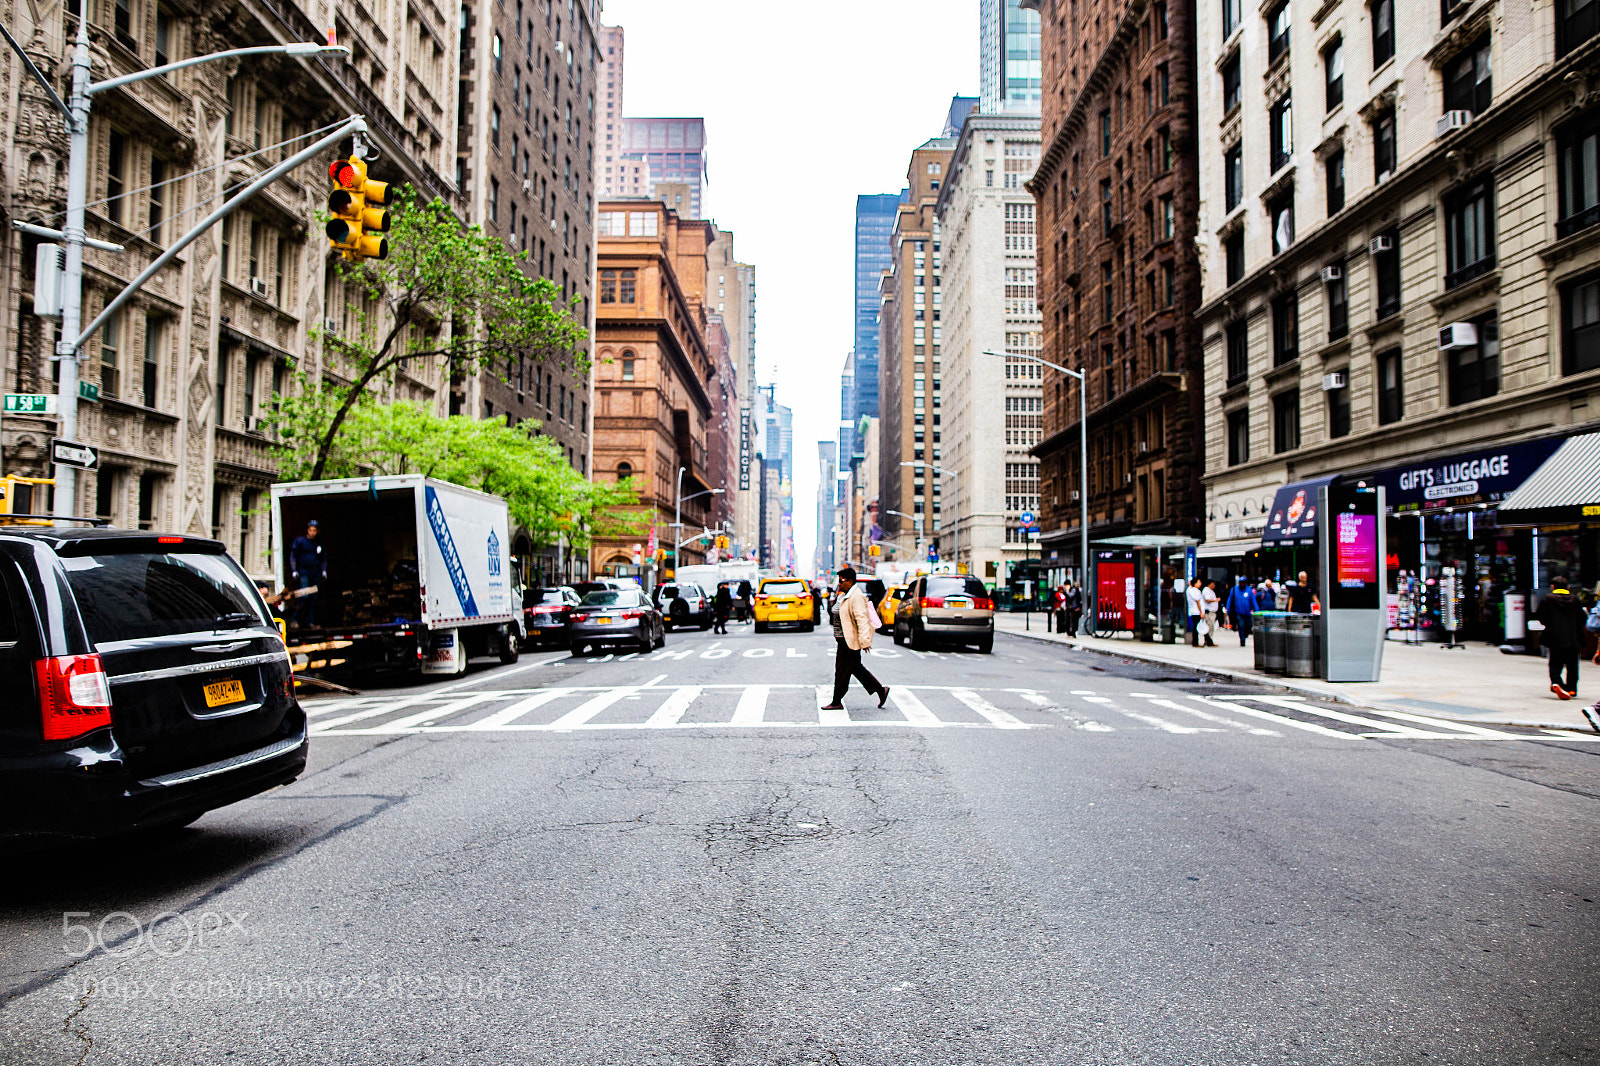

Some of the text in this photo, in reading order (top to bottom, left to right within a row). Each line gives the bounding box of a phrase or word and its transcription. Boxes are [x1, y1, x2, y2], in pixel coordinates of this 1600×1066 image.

[7, 397, 17, 410] W
[20, 397, 33, 410] 58
[60, 448, 71, 457] ONE
[740, 409, 750, 489] WELLINGTON
[1400, 468, 1434, 490] GIFTS
[1443, 455, 1509, 484] LUGGAGE
[1428, 484, 1474, 497] ELECTRONICS
